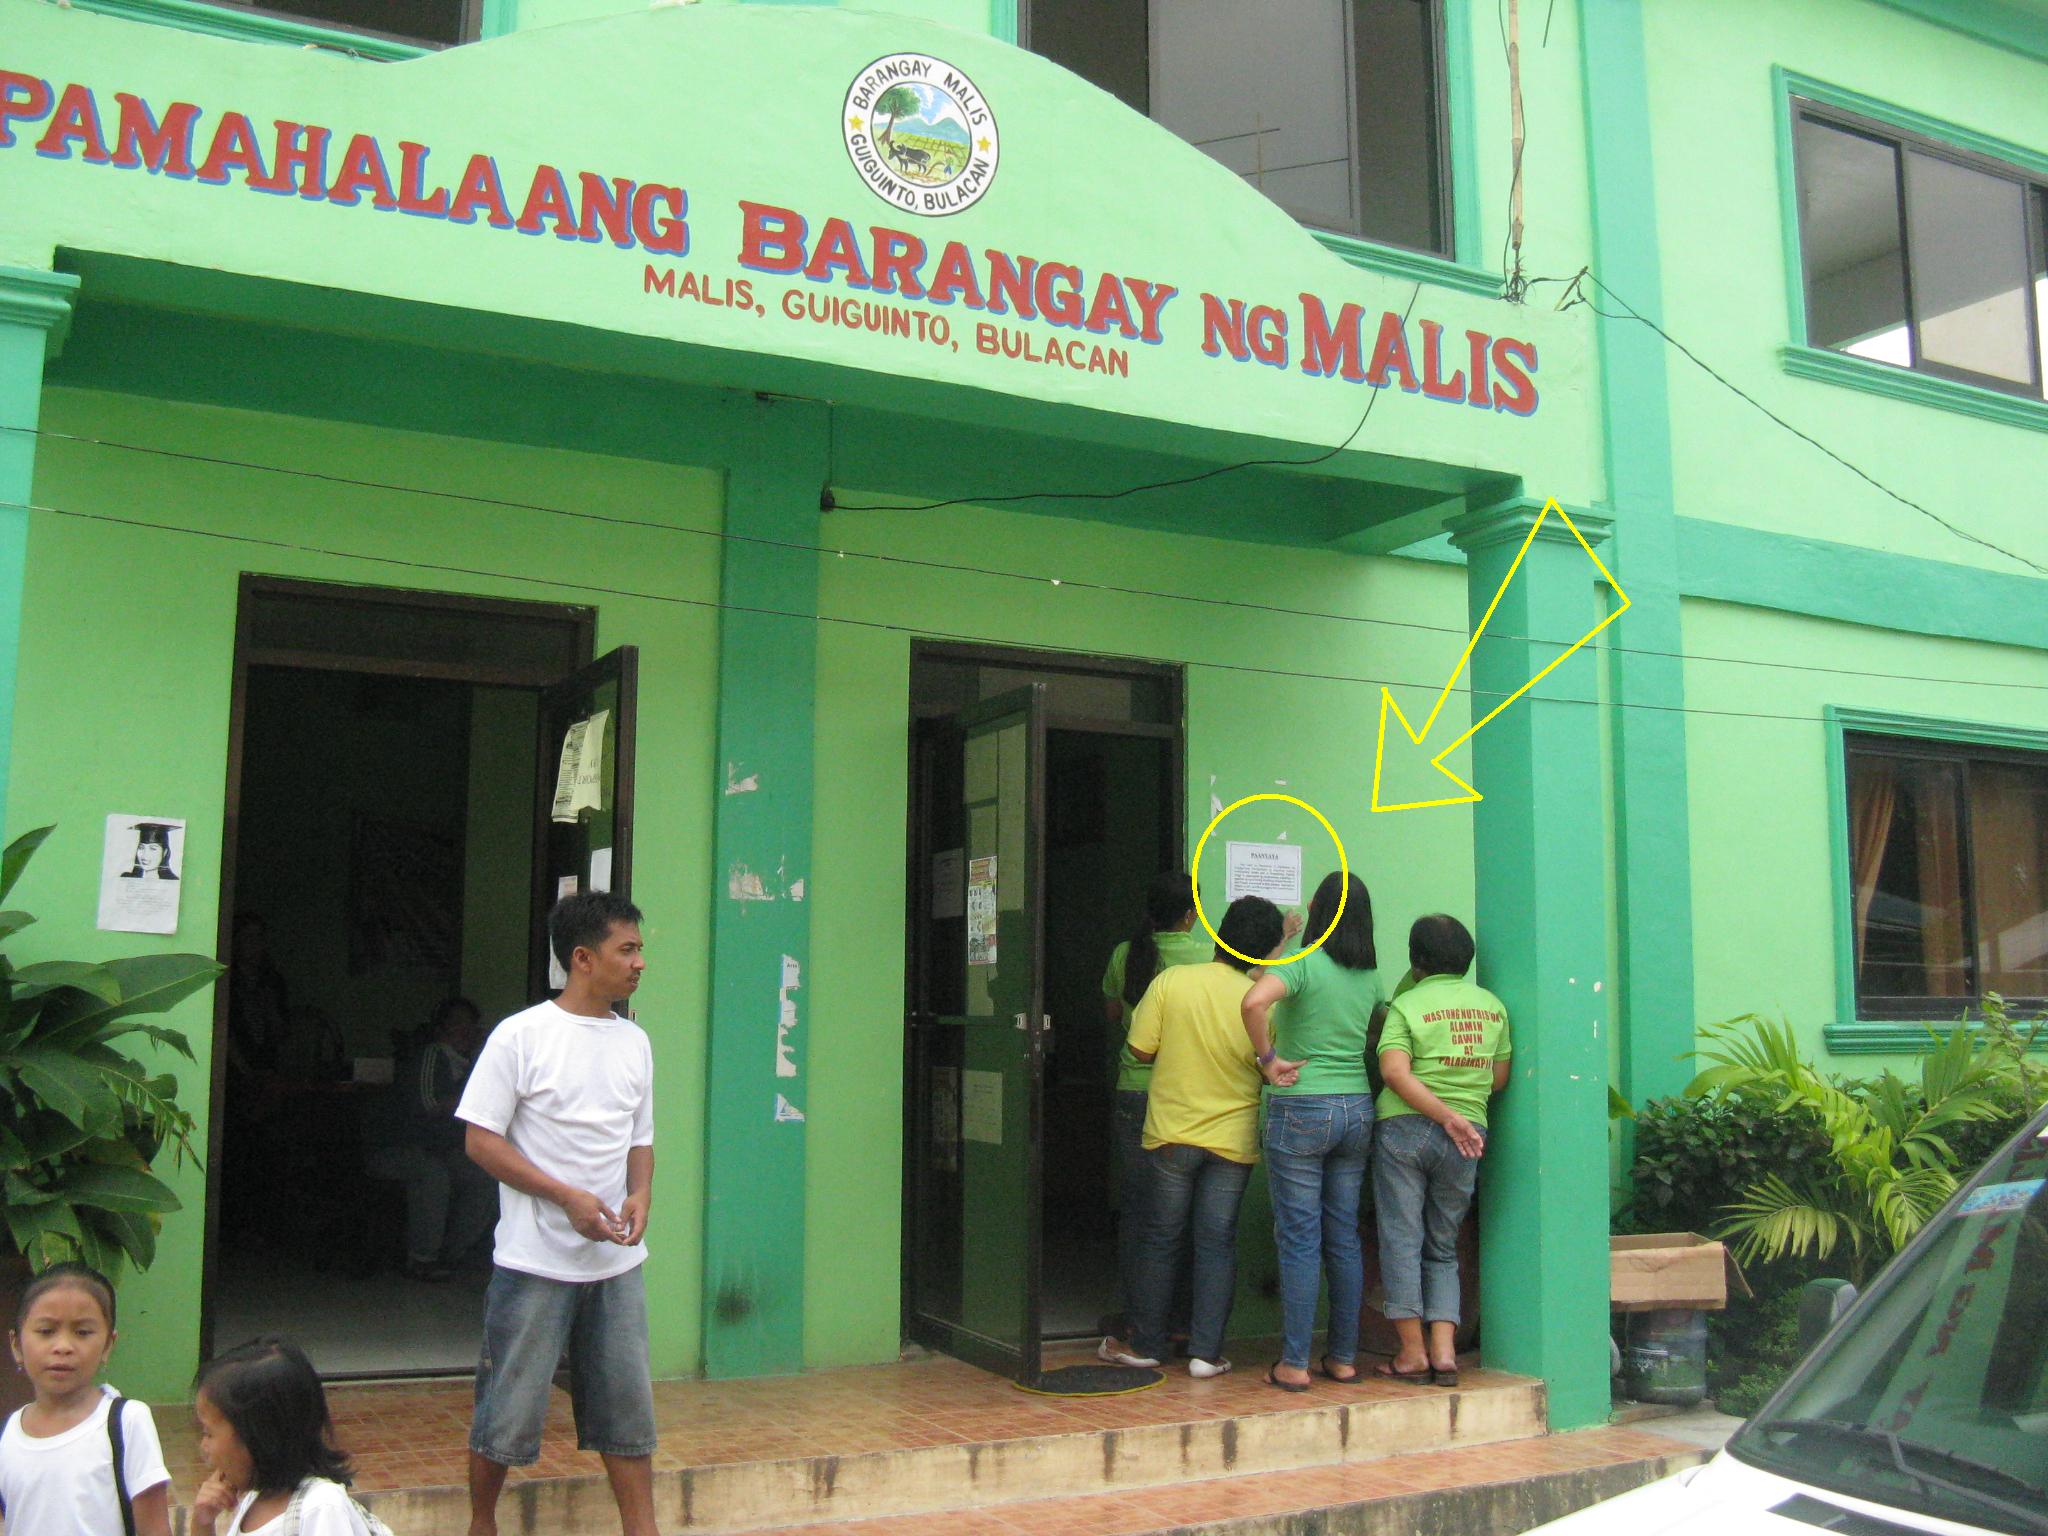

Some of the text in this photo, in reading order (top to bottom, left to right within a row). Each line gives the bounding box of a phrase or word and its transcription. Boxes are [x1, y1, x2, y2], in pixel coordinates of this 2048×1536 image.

[853, 60, 988, 127] BARANGAY MALIS
[850, 133, 990, 211] GUIGUINTO, BULACAN
[0, 70, 1539, 417] PAMAHALAANG BARANGAY NG MALIS
[644, 264, 1129, 378] MALIS, GUIGUINTO, BULACAN
[1423, 1008, 1500, 1023] WASTONG NUTRISON
[1450, 1021, 1483, 1033] ALAMIN
[1452, 1034, 1483, 1045] GAWIN
[1464, 1046, 1473, 1056] AT
